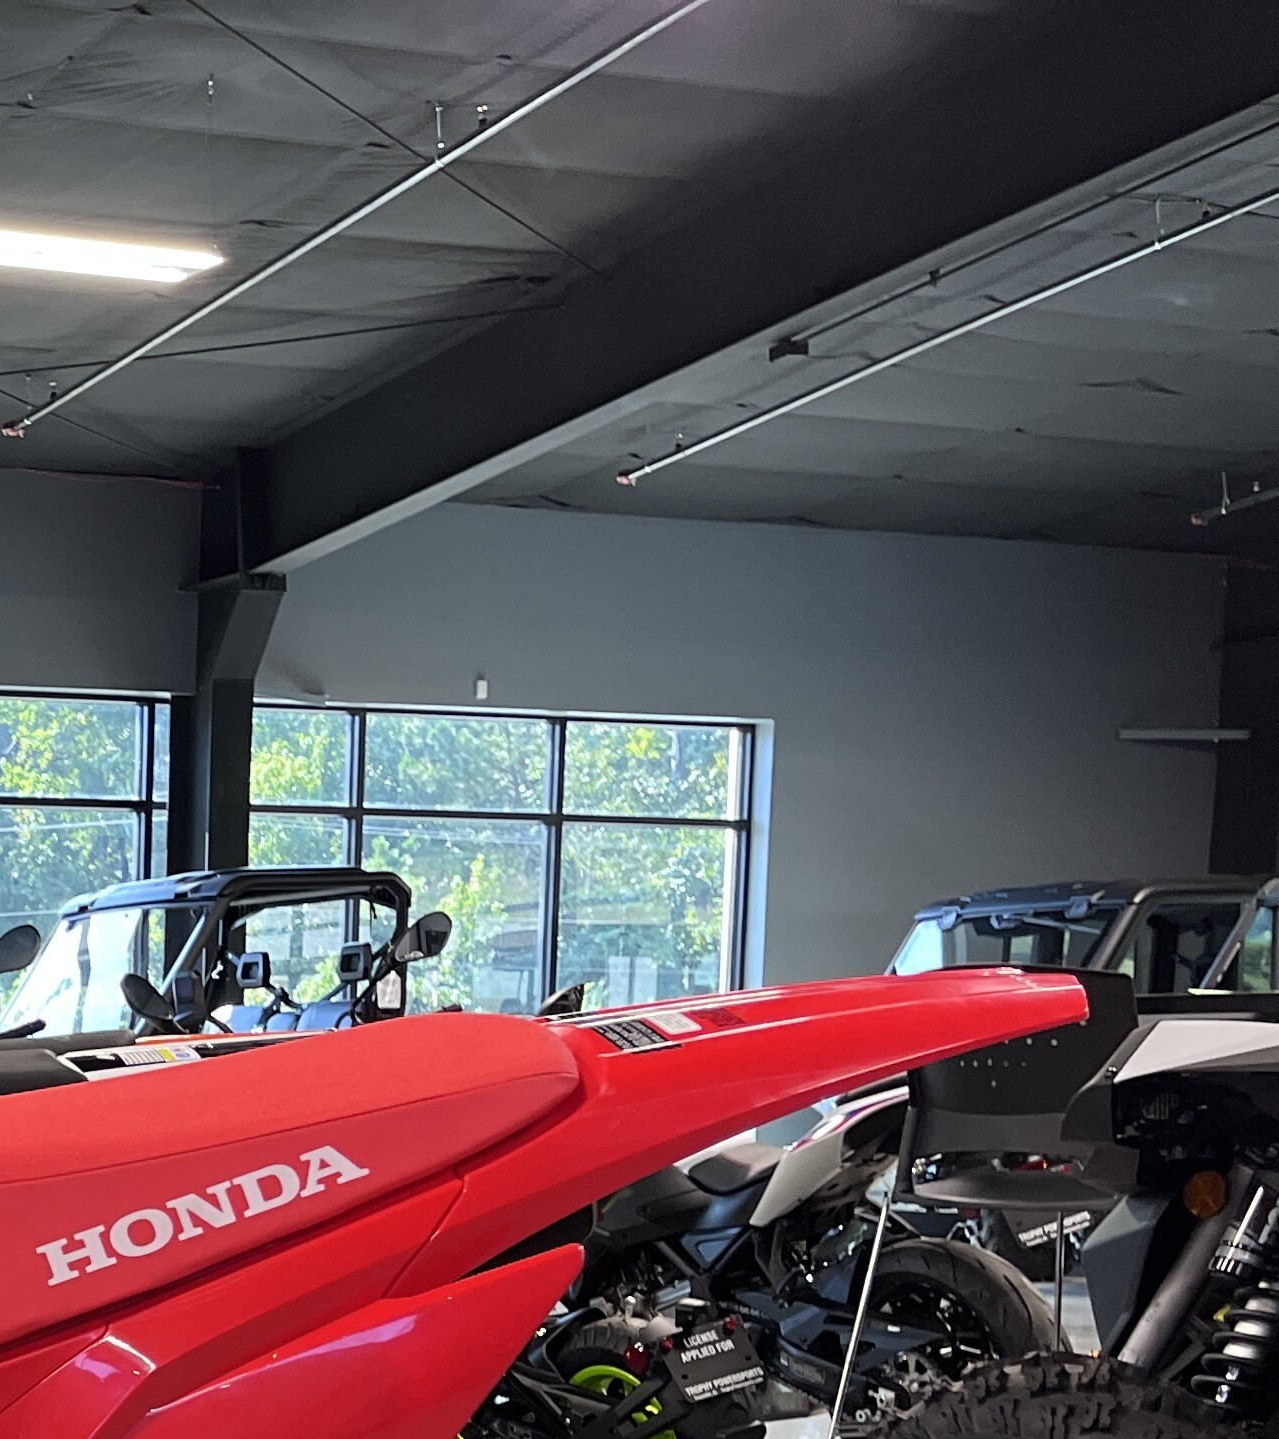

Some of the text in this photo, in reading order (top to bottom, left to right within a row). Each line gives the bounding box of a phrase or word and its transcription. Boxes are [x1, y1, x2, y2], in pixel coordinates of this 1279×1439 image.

[35, 1144, 371, 1287] HONDA
[683, 1329, 719, 1349] LICENSE
[680, 1338, 735, 1364] APPLIED FOR
[685, 1381, 713, 1397] TROPHY
